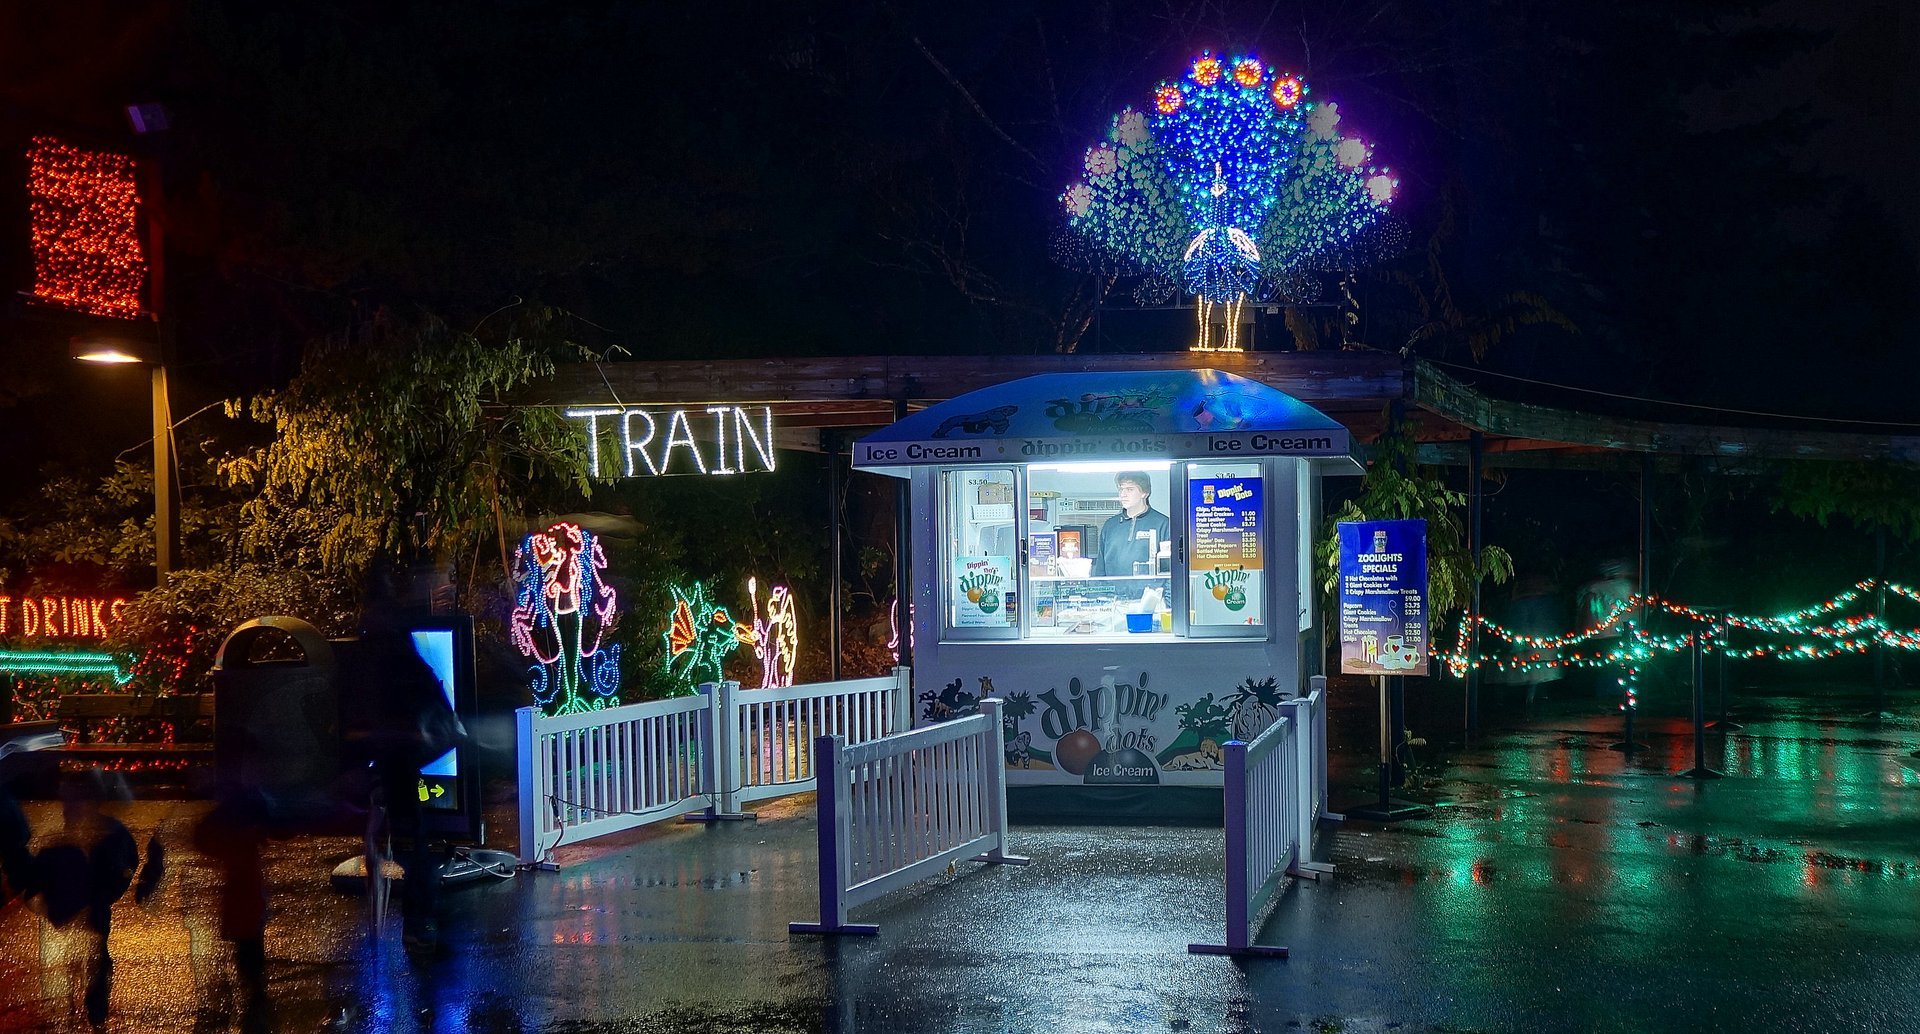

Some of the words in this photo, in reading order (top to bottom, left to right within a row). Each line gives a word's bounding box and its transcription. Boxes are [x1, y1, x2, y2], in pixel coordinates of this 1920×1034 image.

[567, 406, 776, 478] TRAIN
[1021, 438, 1102, 457] dippin'
[1111, 438, 1167, 453] dots
[1208, 435, 1242, 451] Ice
[1250, 434, 1332, 450] Cream
[866, 445, 898, 461] Ice
[906, 444, 981, 460] Cream
[1217, 483, 1243, 498] Dippin'
[1234, 490, 1253, 501] Dots
[1357, 554, 1403, 563] ZOOLIGHTS
[1362, 564, 1397, 573] SPECIALS
[958, 570, 1003, 593] dippin'
[1204, 565, 1250, 590] dippin'
[1228, 585, 1247, 594] dots
[1037, 672, 1169, 739] dippin'
[1106, 727, 1157, 753] dots
[1092, 764, 1110, 776] Ice
[1113, 764, 1154, 777] Cream
